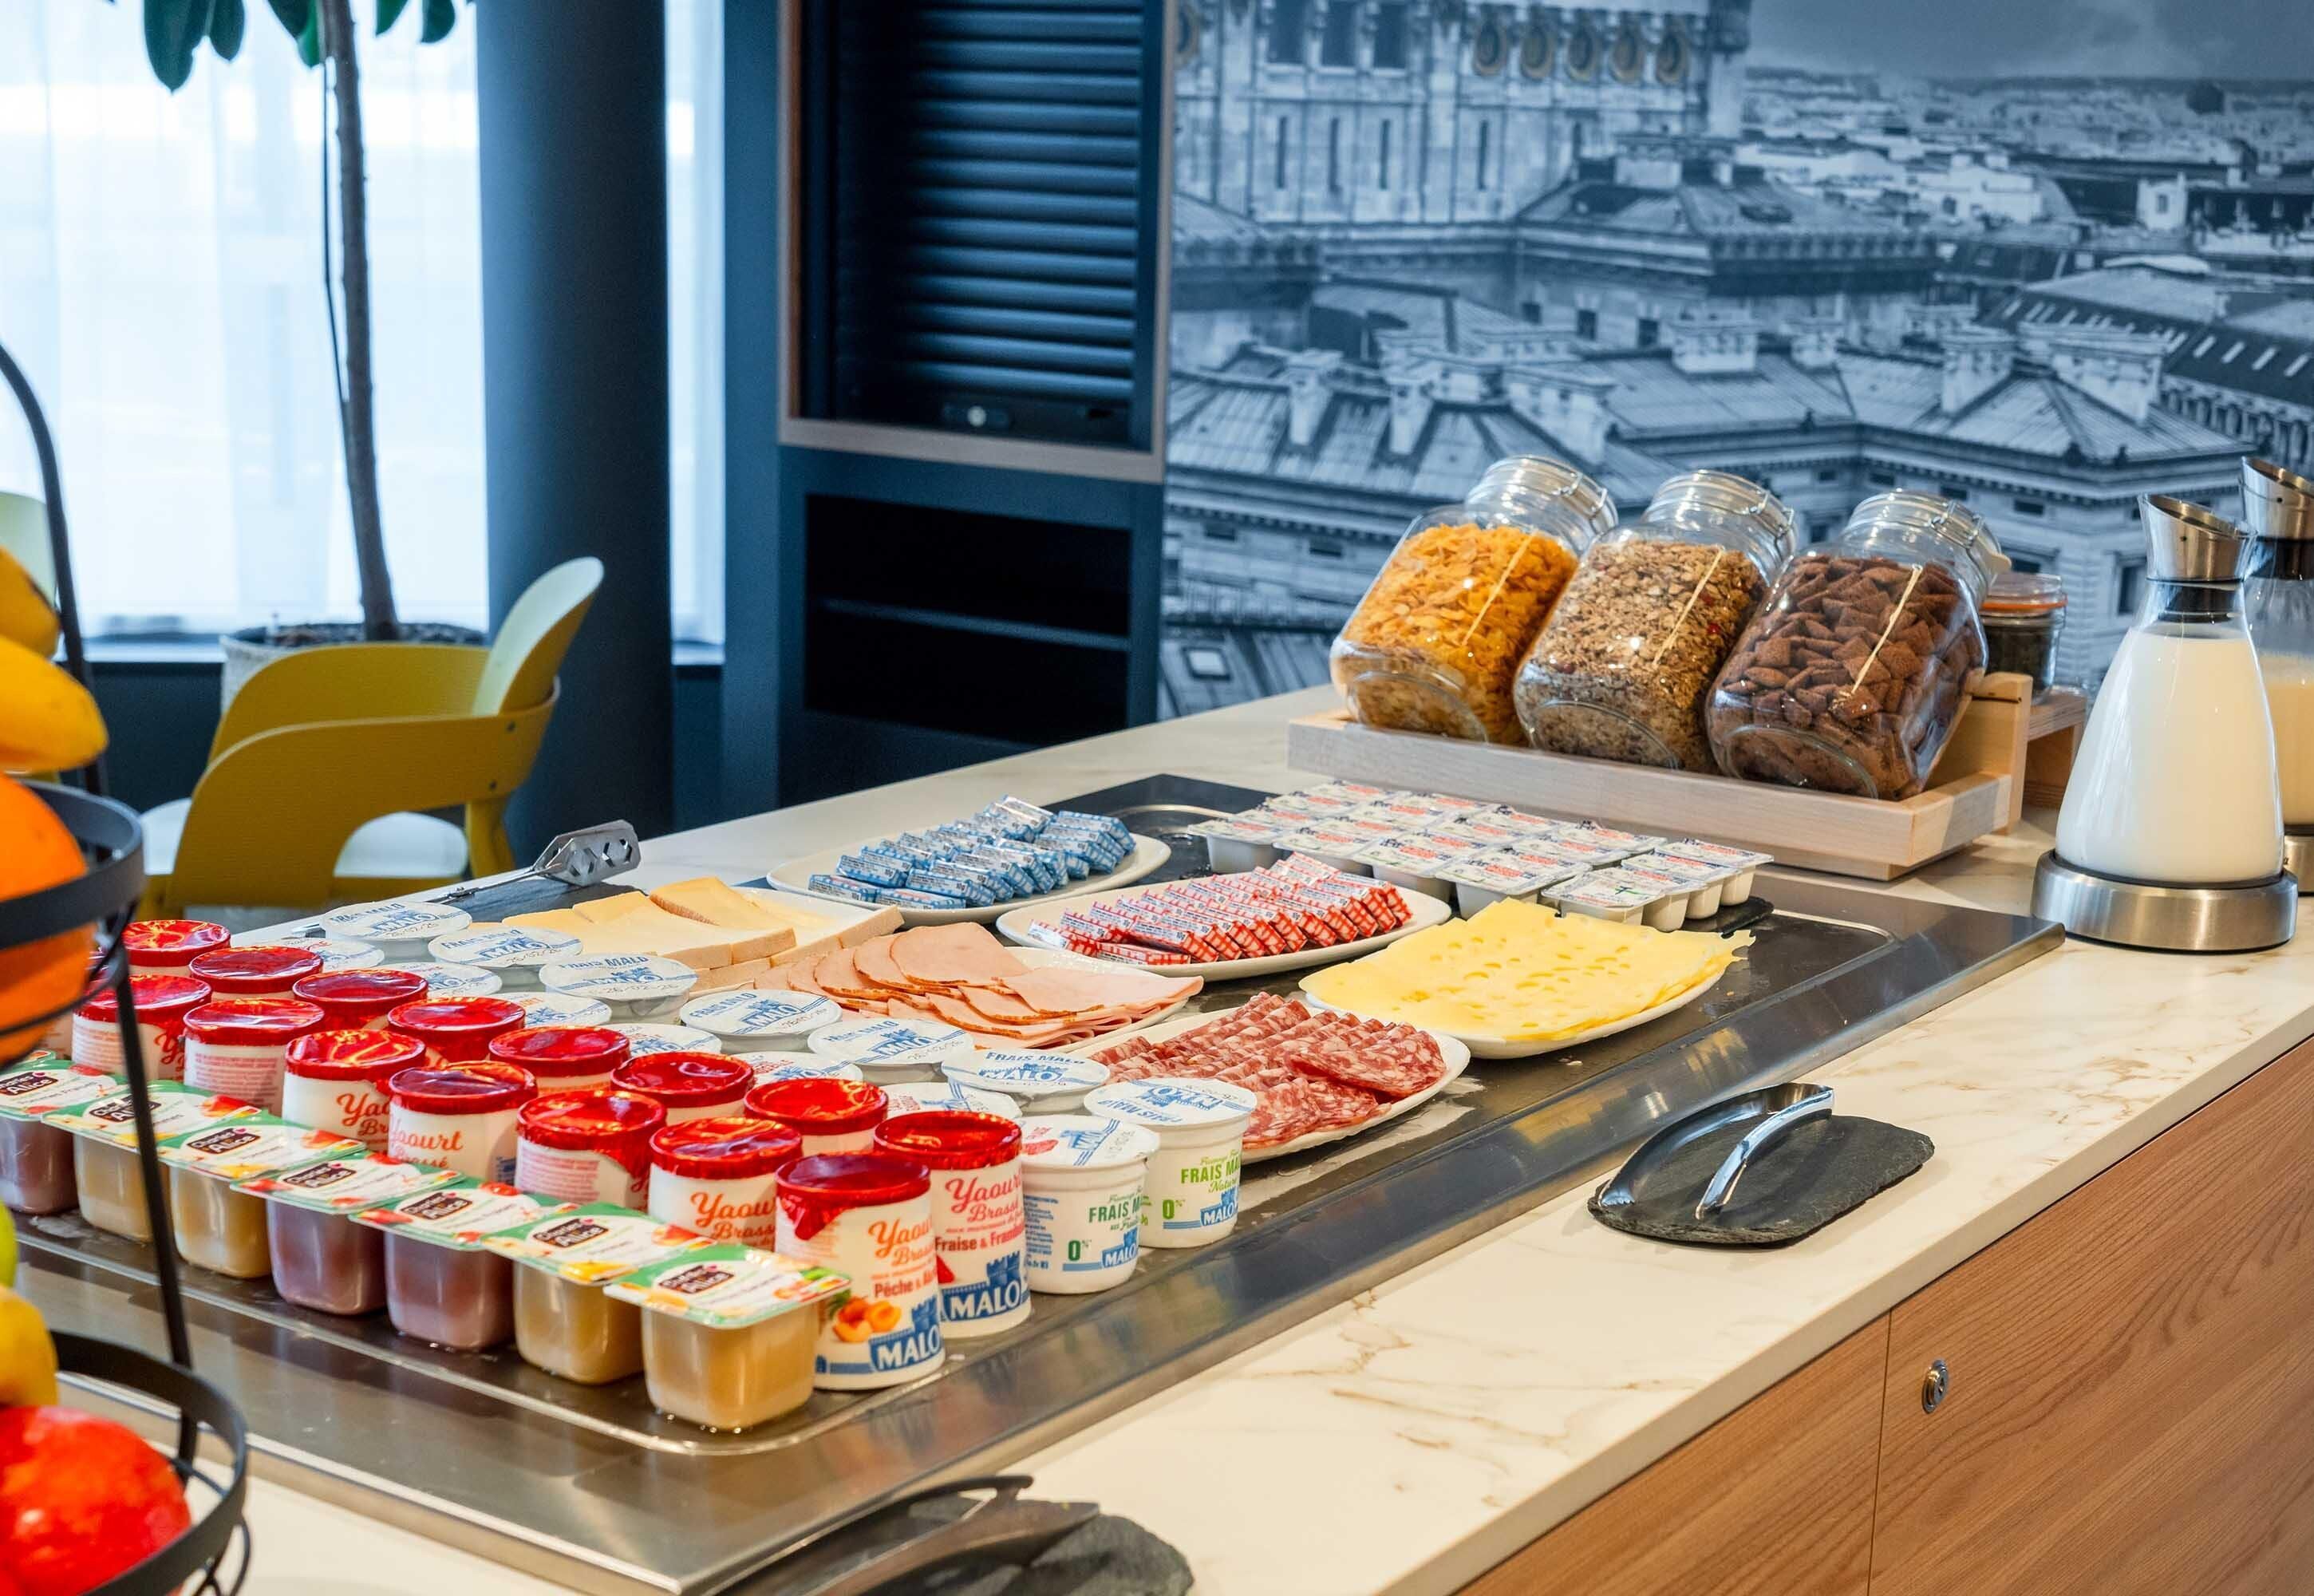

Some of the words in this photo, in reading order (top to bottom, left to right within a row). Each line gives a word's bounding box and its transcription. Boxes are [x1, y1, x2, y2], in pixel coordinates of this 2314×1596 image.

[604, 956, 650, 968] MALO
[985, 1051, 1034, 1062] FRAIS
[981, 1067, 1063, 1082] MALO
[6, 1078, 53, 1095] Alice
[1181, 1163, 1222, 1184] FRAIS
[1088, 1200, 1129, 1223] FRAIS
[1202, 1203, 1234, 1227] MALO
[934, 1236, 977, 1251] Fraise
[1104, 1242, 1136, 1269] MALO
[950, 1279, 1021, 1318] MALO
[878, 1324, 939, 1369] MALO
